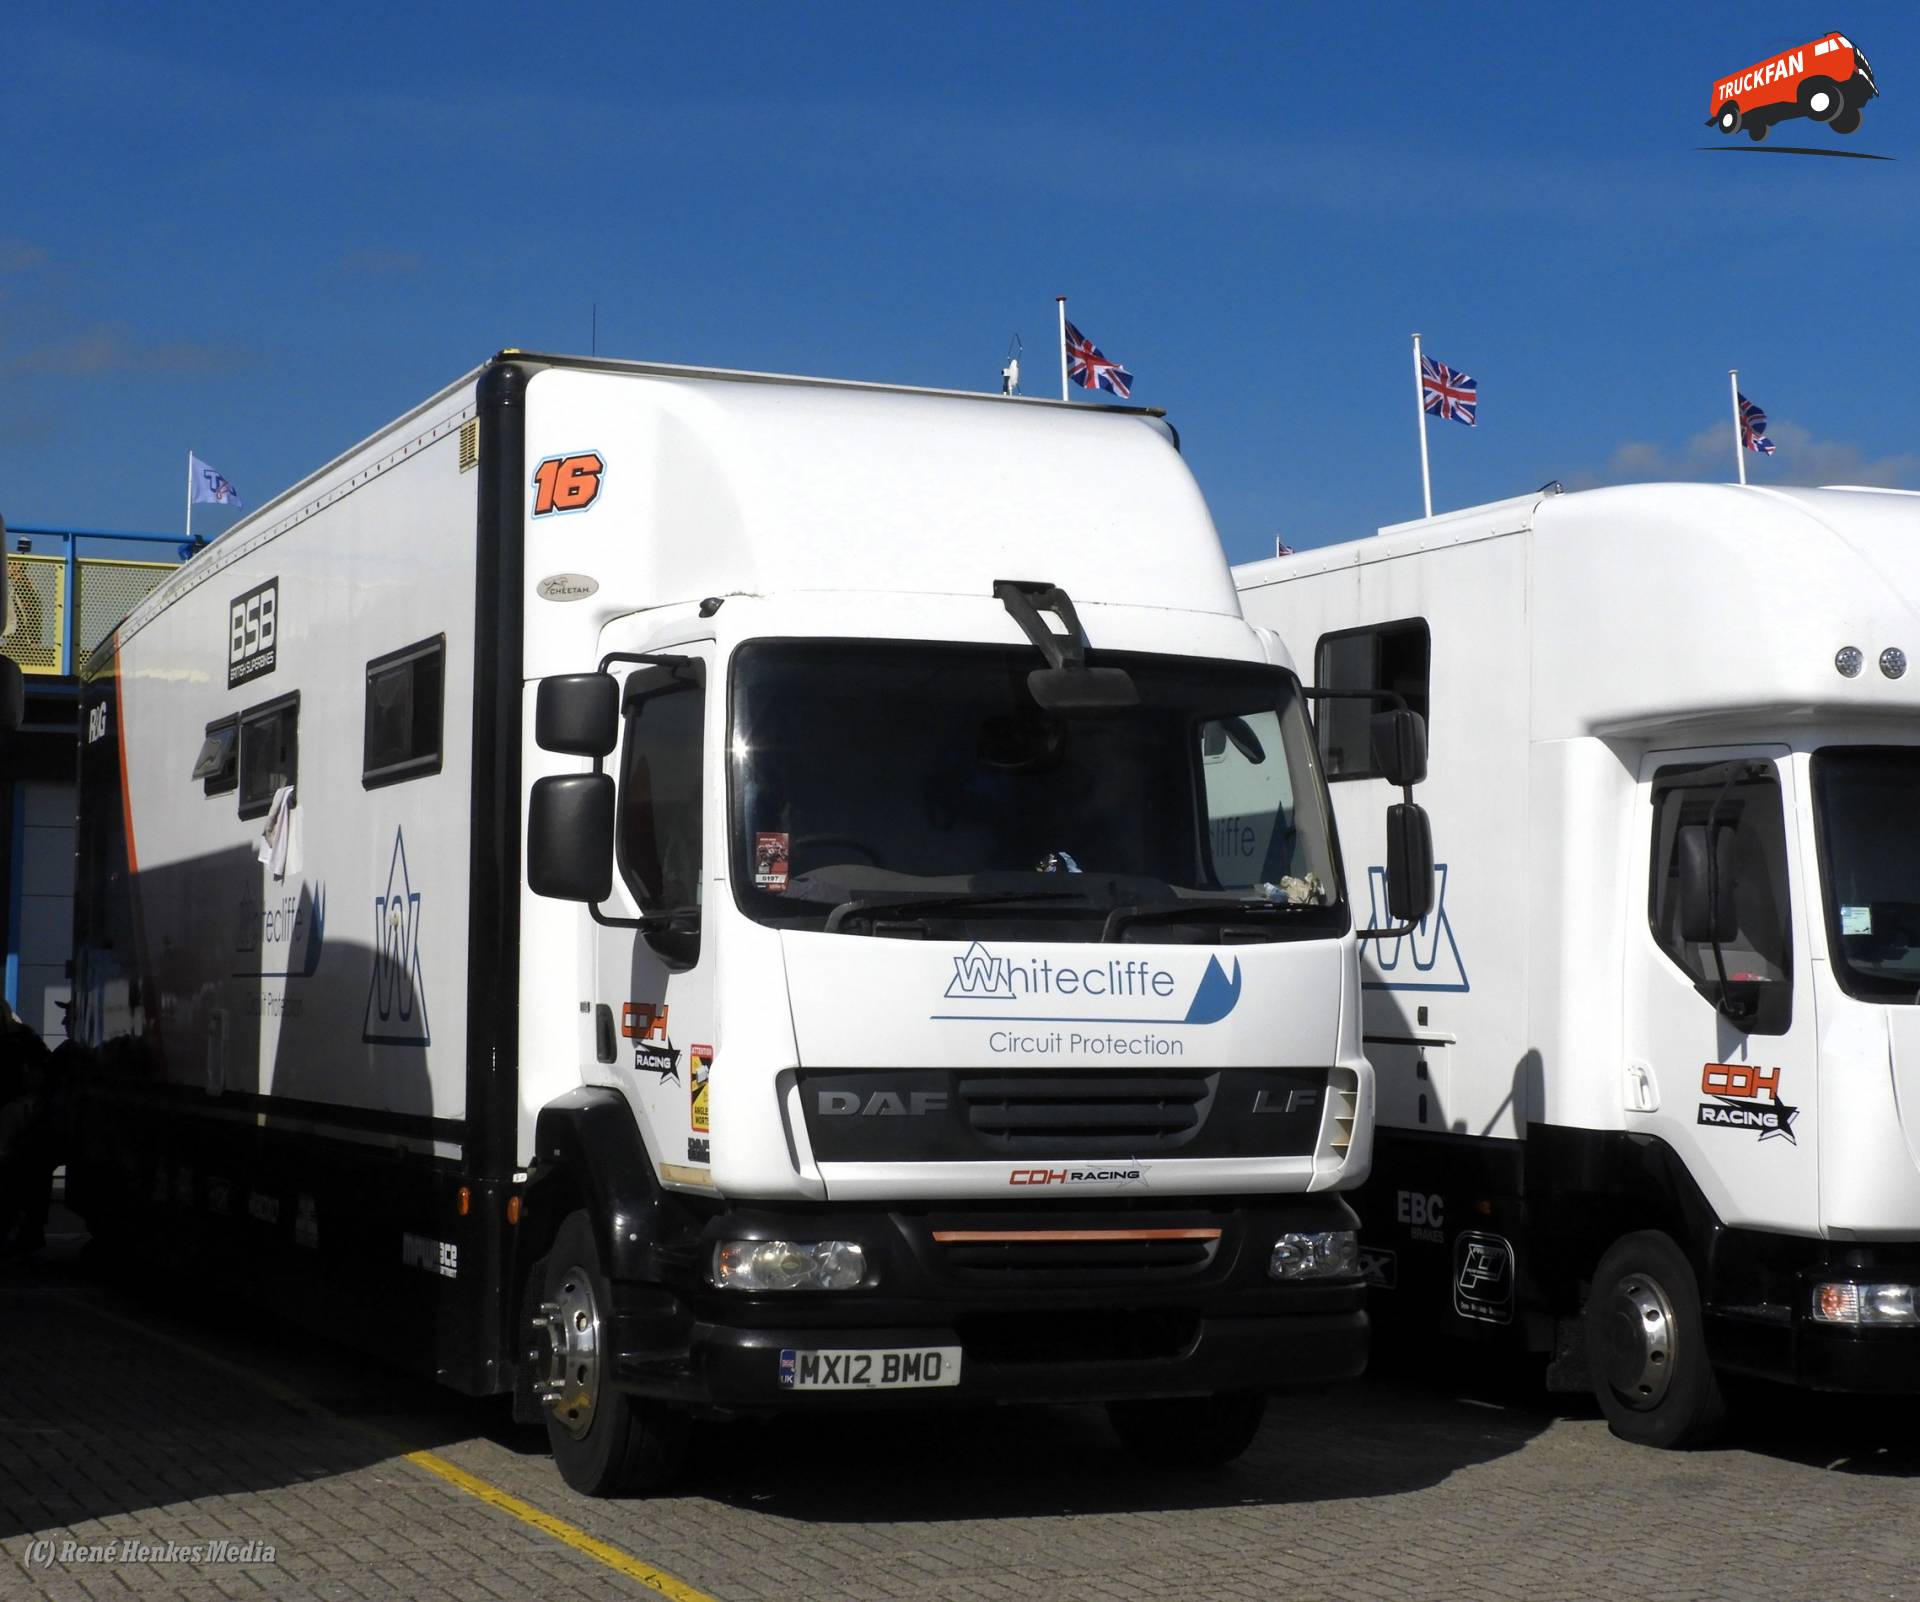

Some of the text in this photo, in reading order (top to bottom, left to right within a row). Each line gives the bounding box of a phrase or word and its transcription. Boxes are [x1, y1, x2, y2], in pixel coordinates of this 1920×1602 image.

[533, 452, 604, 517] 16
[550, 586, 590, 596] CHEETAH
[230, 587, 276, 665] BSB
[951, 951, 1175, 997] Whitecliffe
[989, 1031, 1184, 1056] Circuit Protection
[635, 1054, 672, 1069] RACING
[817, 1090, 948, 1116] DAF
[1252, 1089, 1318, 1114] LF
[1701, 1107, 1779, 1127] RACING
[1070, 1168, 1140, 1183] RACING
[1397, 1189, 1445, 1228] EBC
[781, 1375, 793, 1384] UK
[799, 1351, 942, 1385] MX12 BMO
